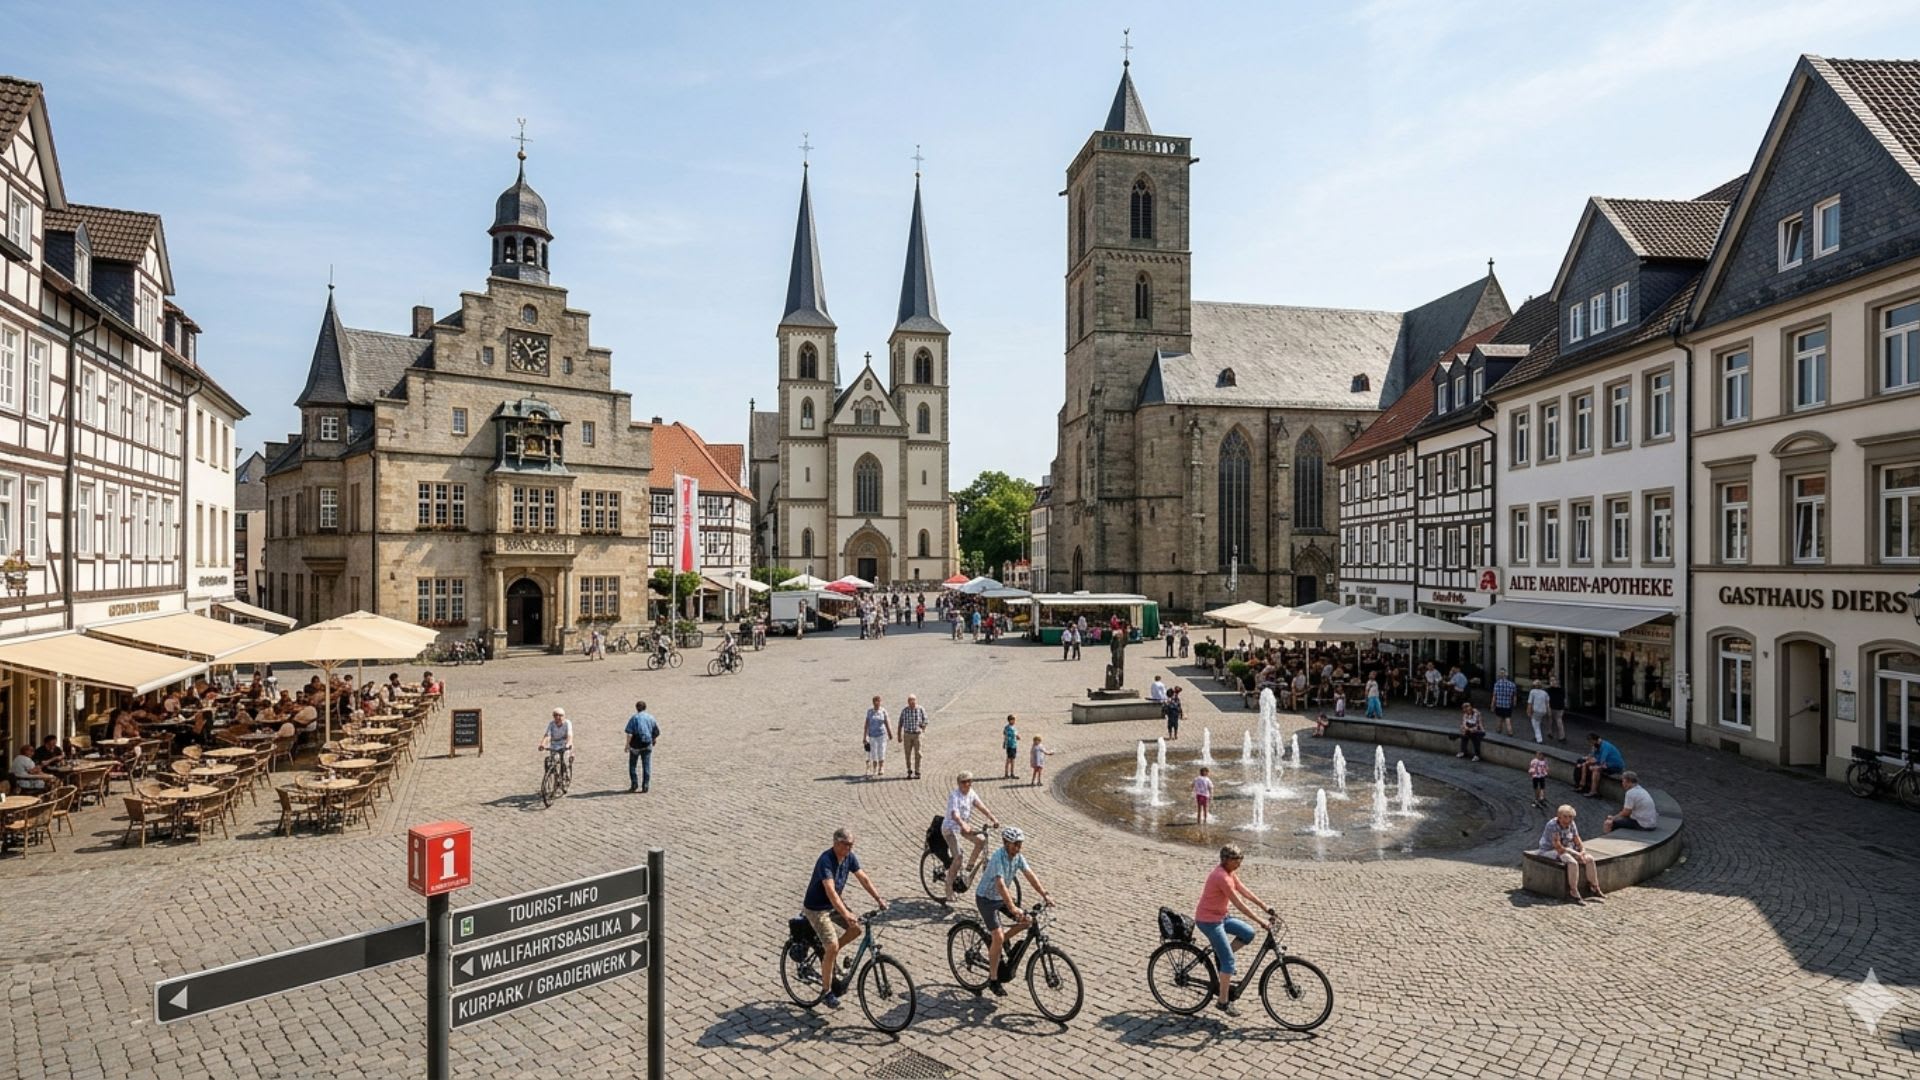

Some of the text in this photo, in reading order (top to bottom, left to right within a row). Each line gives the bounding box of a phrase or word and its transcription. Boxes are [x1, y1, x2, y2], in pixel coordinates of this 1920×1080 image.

[1480, 570, 1498, 591] A
[1509, 575, 1674, 597] ALTE MARIEN-APOTHEKE
[1719, 586, 1909, 614] GASTHAUS DIERS
[508, 886, 599, 924] TOURIST-INFO
[458, 952, 627, 1020] KURPARK / GRADIERWERK
